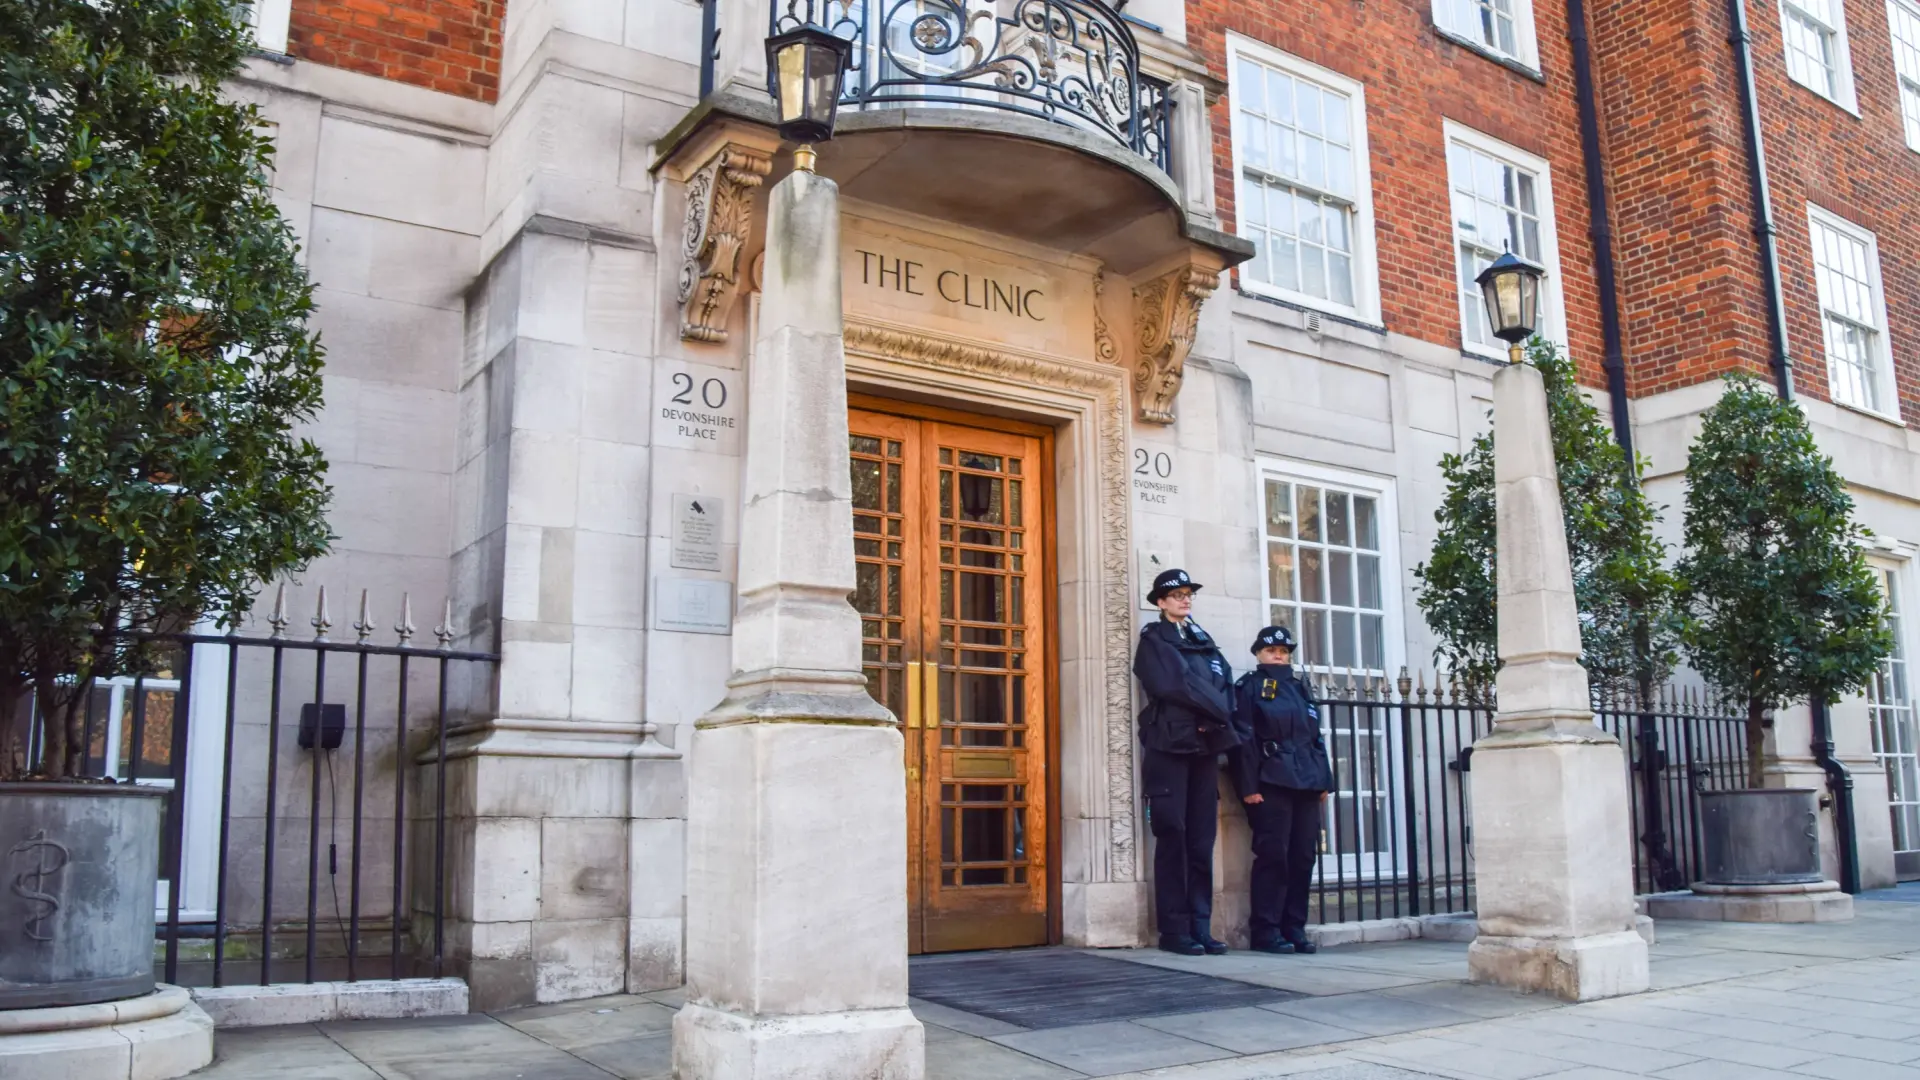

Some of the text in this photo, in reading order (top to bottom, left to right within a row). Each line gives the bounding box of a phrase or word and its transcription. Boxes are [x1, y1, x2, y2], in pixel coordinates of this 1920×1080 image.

[855, 249, 1045, 321] THE CLINIC
[671, 372, 727, 409] 20
[662, 407, 735, 428] DEVONSHIRE
[678, 425, 717, 440] PLACE
[1134, 448, 1172, 478] 20
[1132, 479, 1178, 494] EVONSHIRE
[1140, 491, 1167, 504] PLACE
